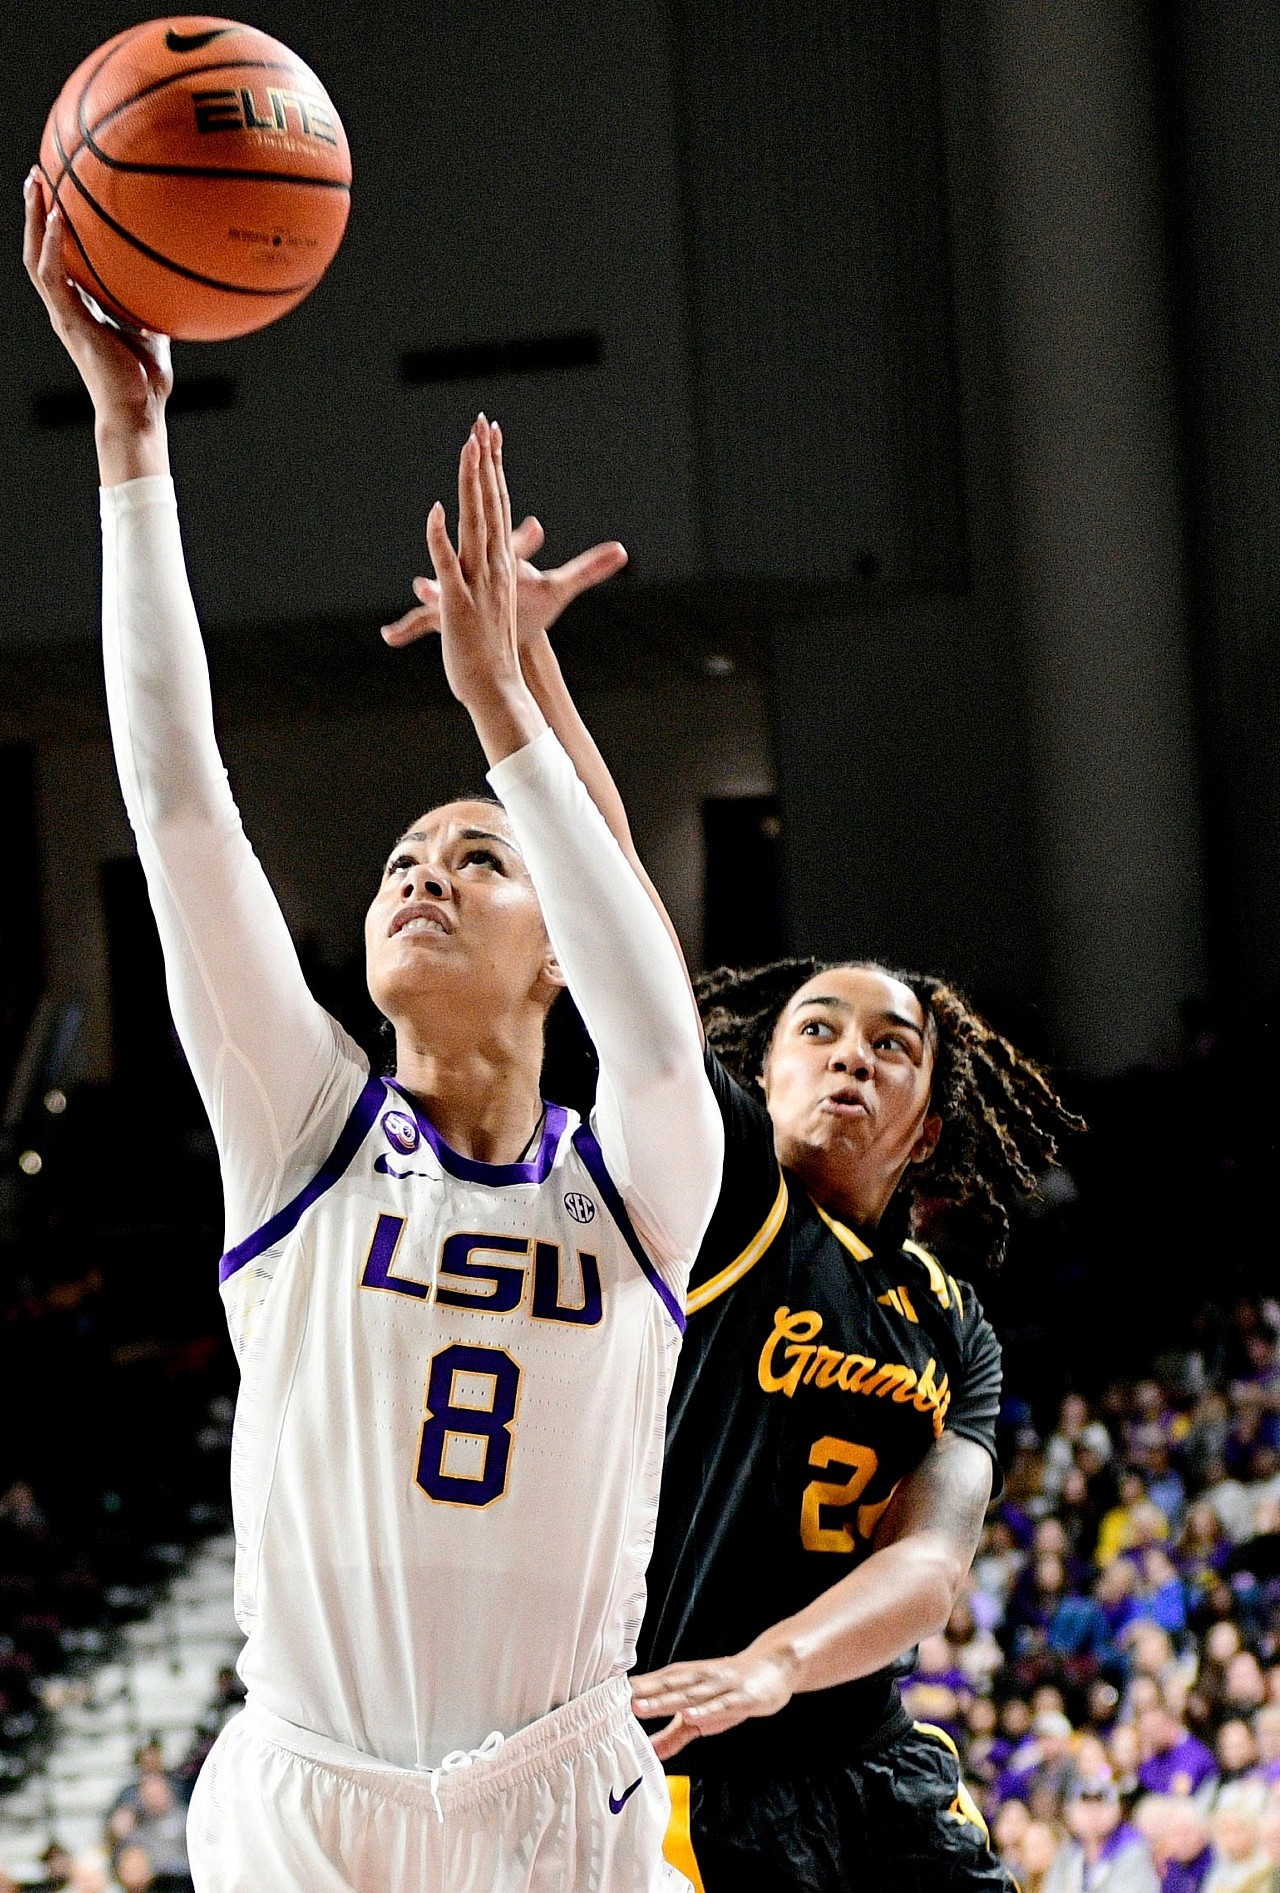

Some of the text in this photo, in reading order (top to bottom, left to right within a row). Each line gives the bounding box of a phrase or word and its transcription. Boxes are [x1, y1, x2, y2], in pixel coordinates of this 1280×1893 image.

[191, 86, 338, 147] ELITE
[564, 1192, 595, 1223] SEC
[359, 1209, 605, 1329] LSU
[413, 1341, 525, 1511] 8
